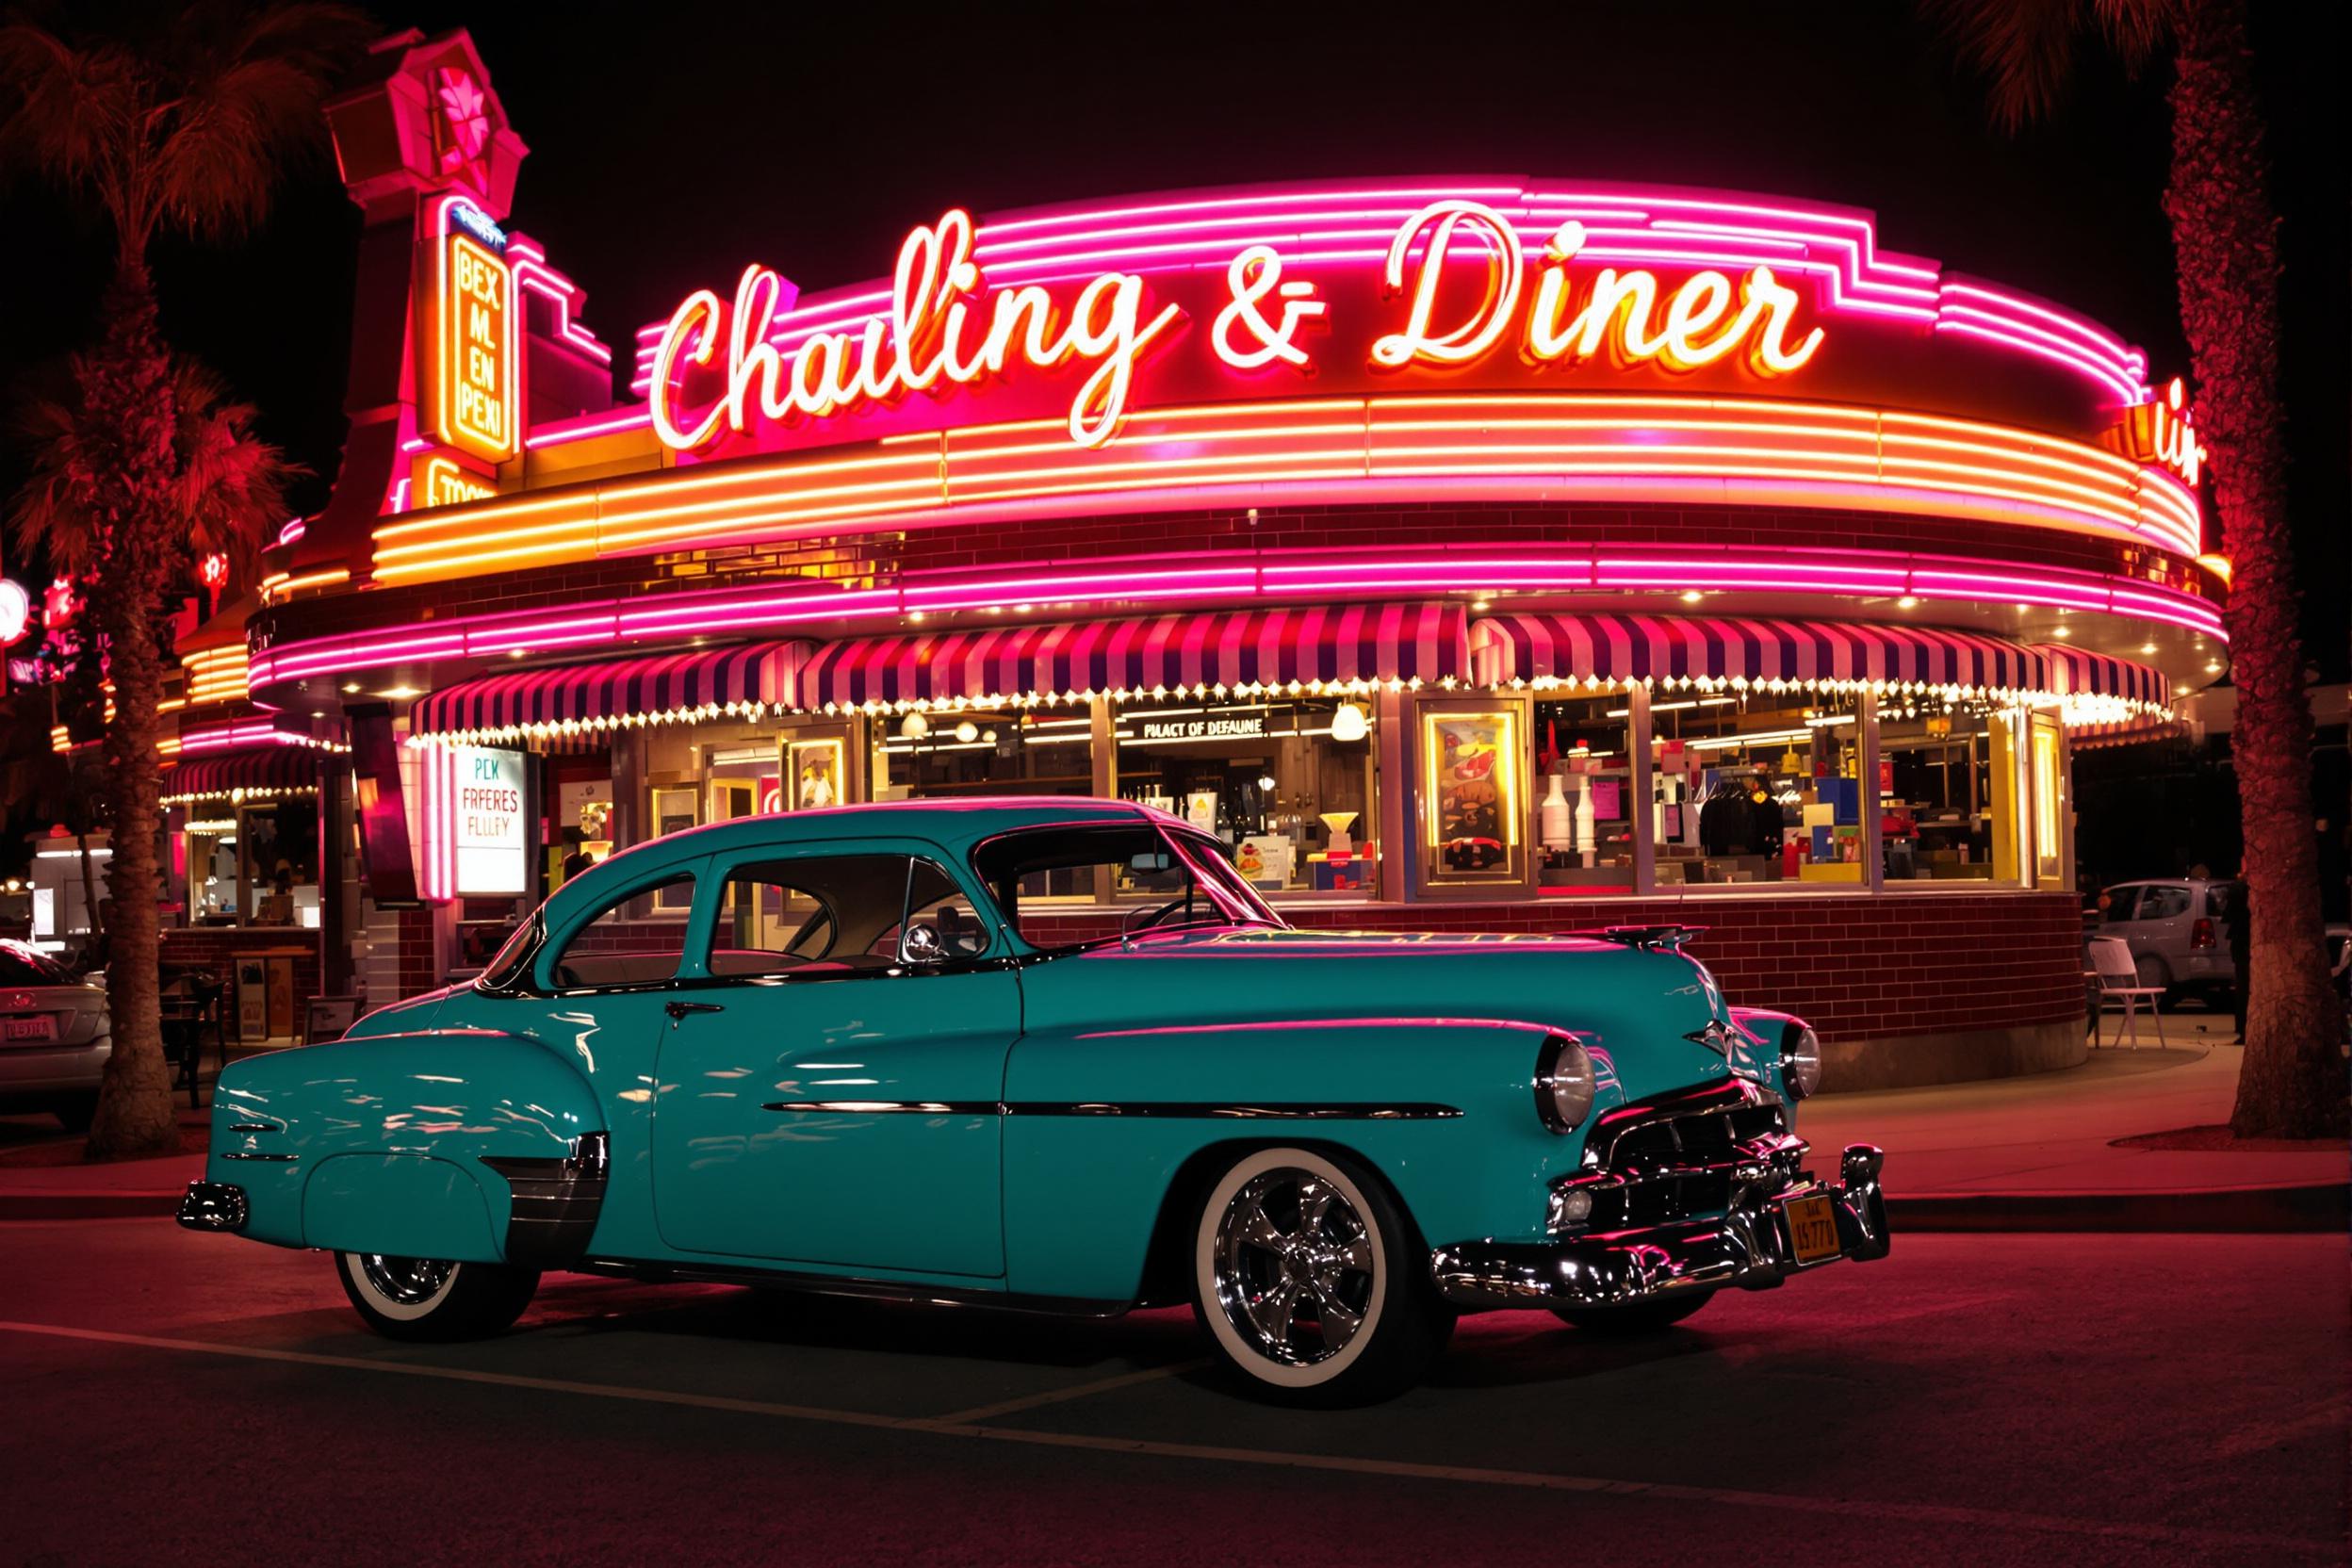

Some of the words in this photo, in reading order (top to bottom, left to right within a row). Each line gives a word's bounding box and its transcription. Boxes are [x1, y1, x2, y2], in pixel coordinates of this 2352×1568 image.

[460, 251, 500, 310] BEX
[1212, 245, 1326, 368] &
[1372, 200, 1824, 373] Diner
[469, 346, 494, 392] EN
[1188, 721, 1204, 737] OF
